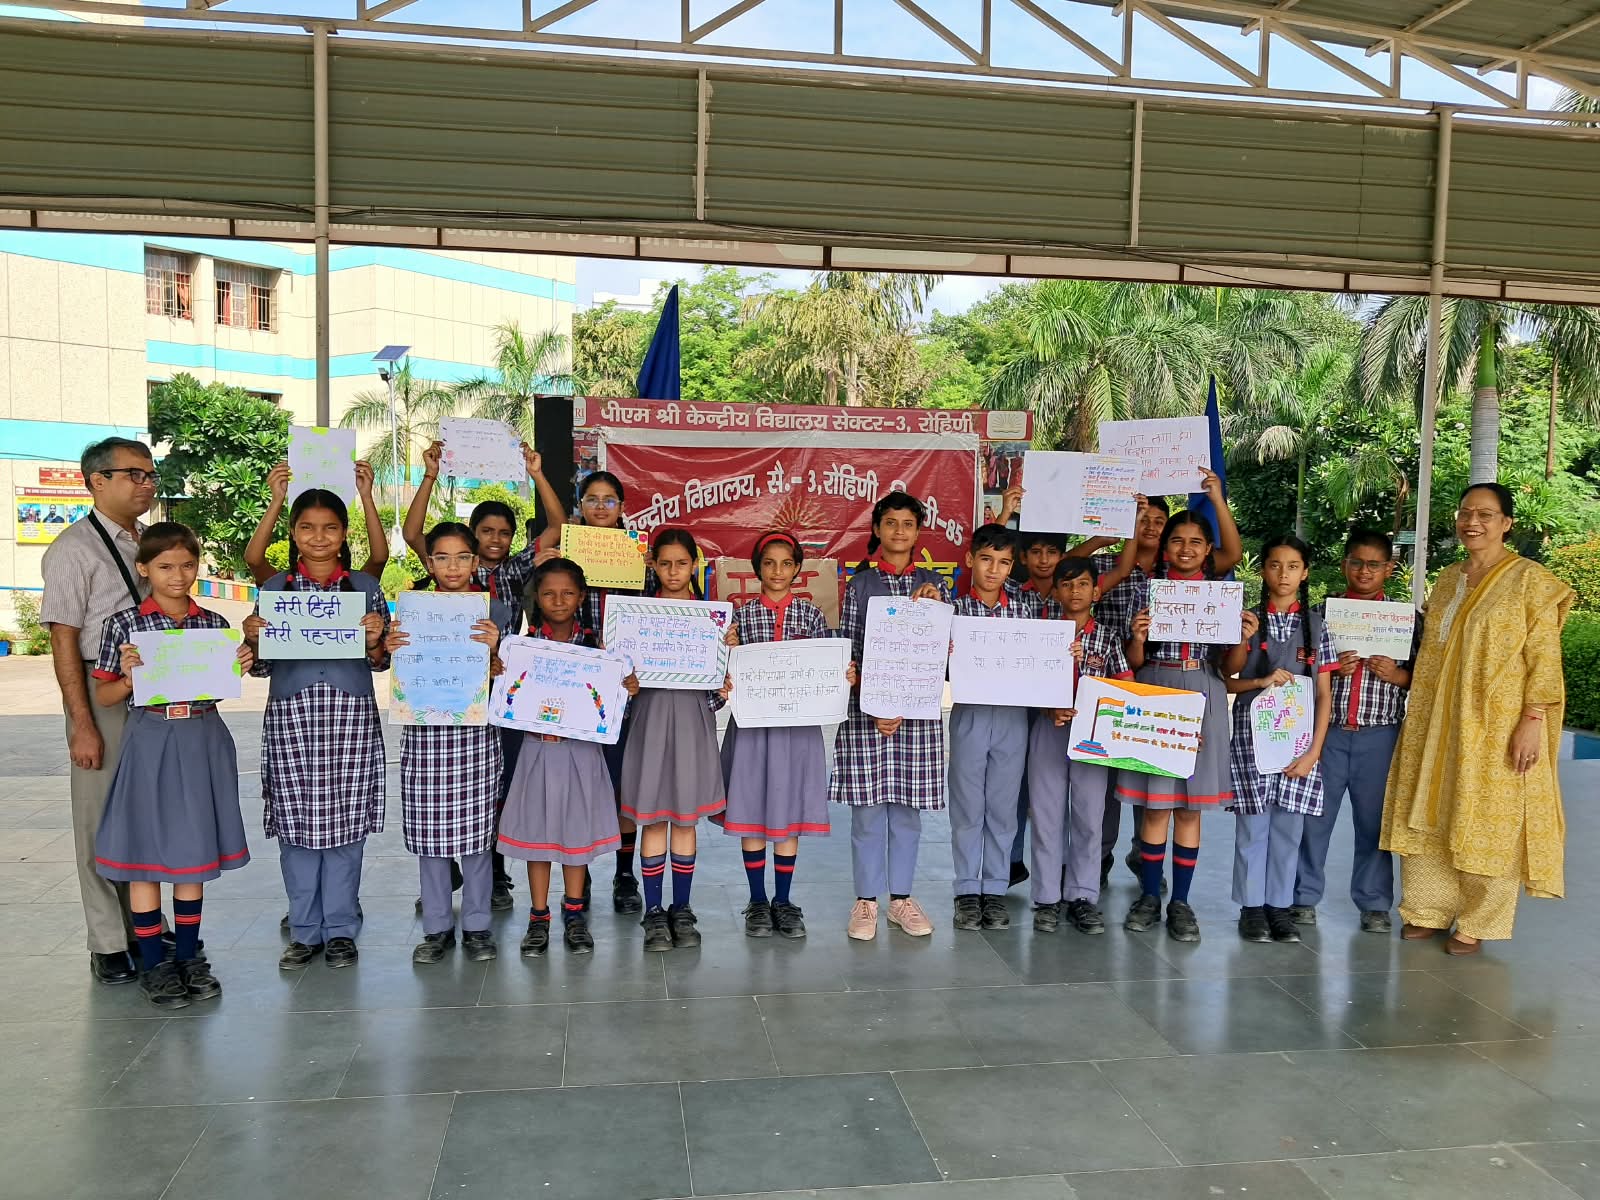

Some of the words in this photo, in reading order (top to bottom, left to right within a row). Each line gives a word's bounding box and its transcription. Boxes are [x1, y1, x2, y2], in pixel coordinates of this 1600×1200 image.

[600, 401, 650, 424] पीएम
[656, 403, 681, 425] श्री
[686, 405, 750, 429] केन्द्रीय
[756, 406, 828, 431] विद्यालय
[833, 409, 911, 433] सेक्टर-3,
[918, 411, 973, 434] रोहिणी
[684, 474, 761, 514] विद्यालय,
[274, 595, 304, 616] मेरी
[306, 594, 341, 620] हिंदी
[264, 621, 294, 642] मेरी
[300, 628, 359, 645] पहचान
